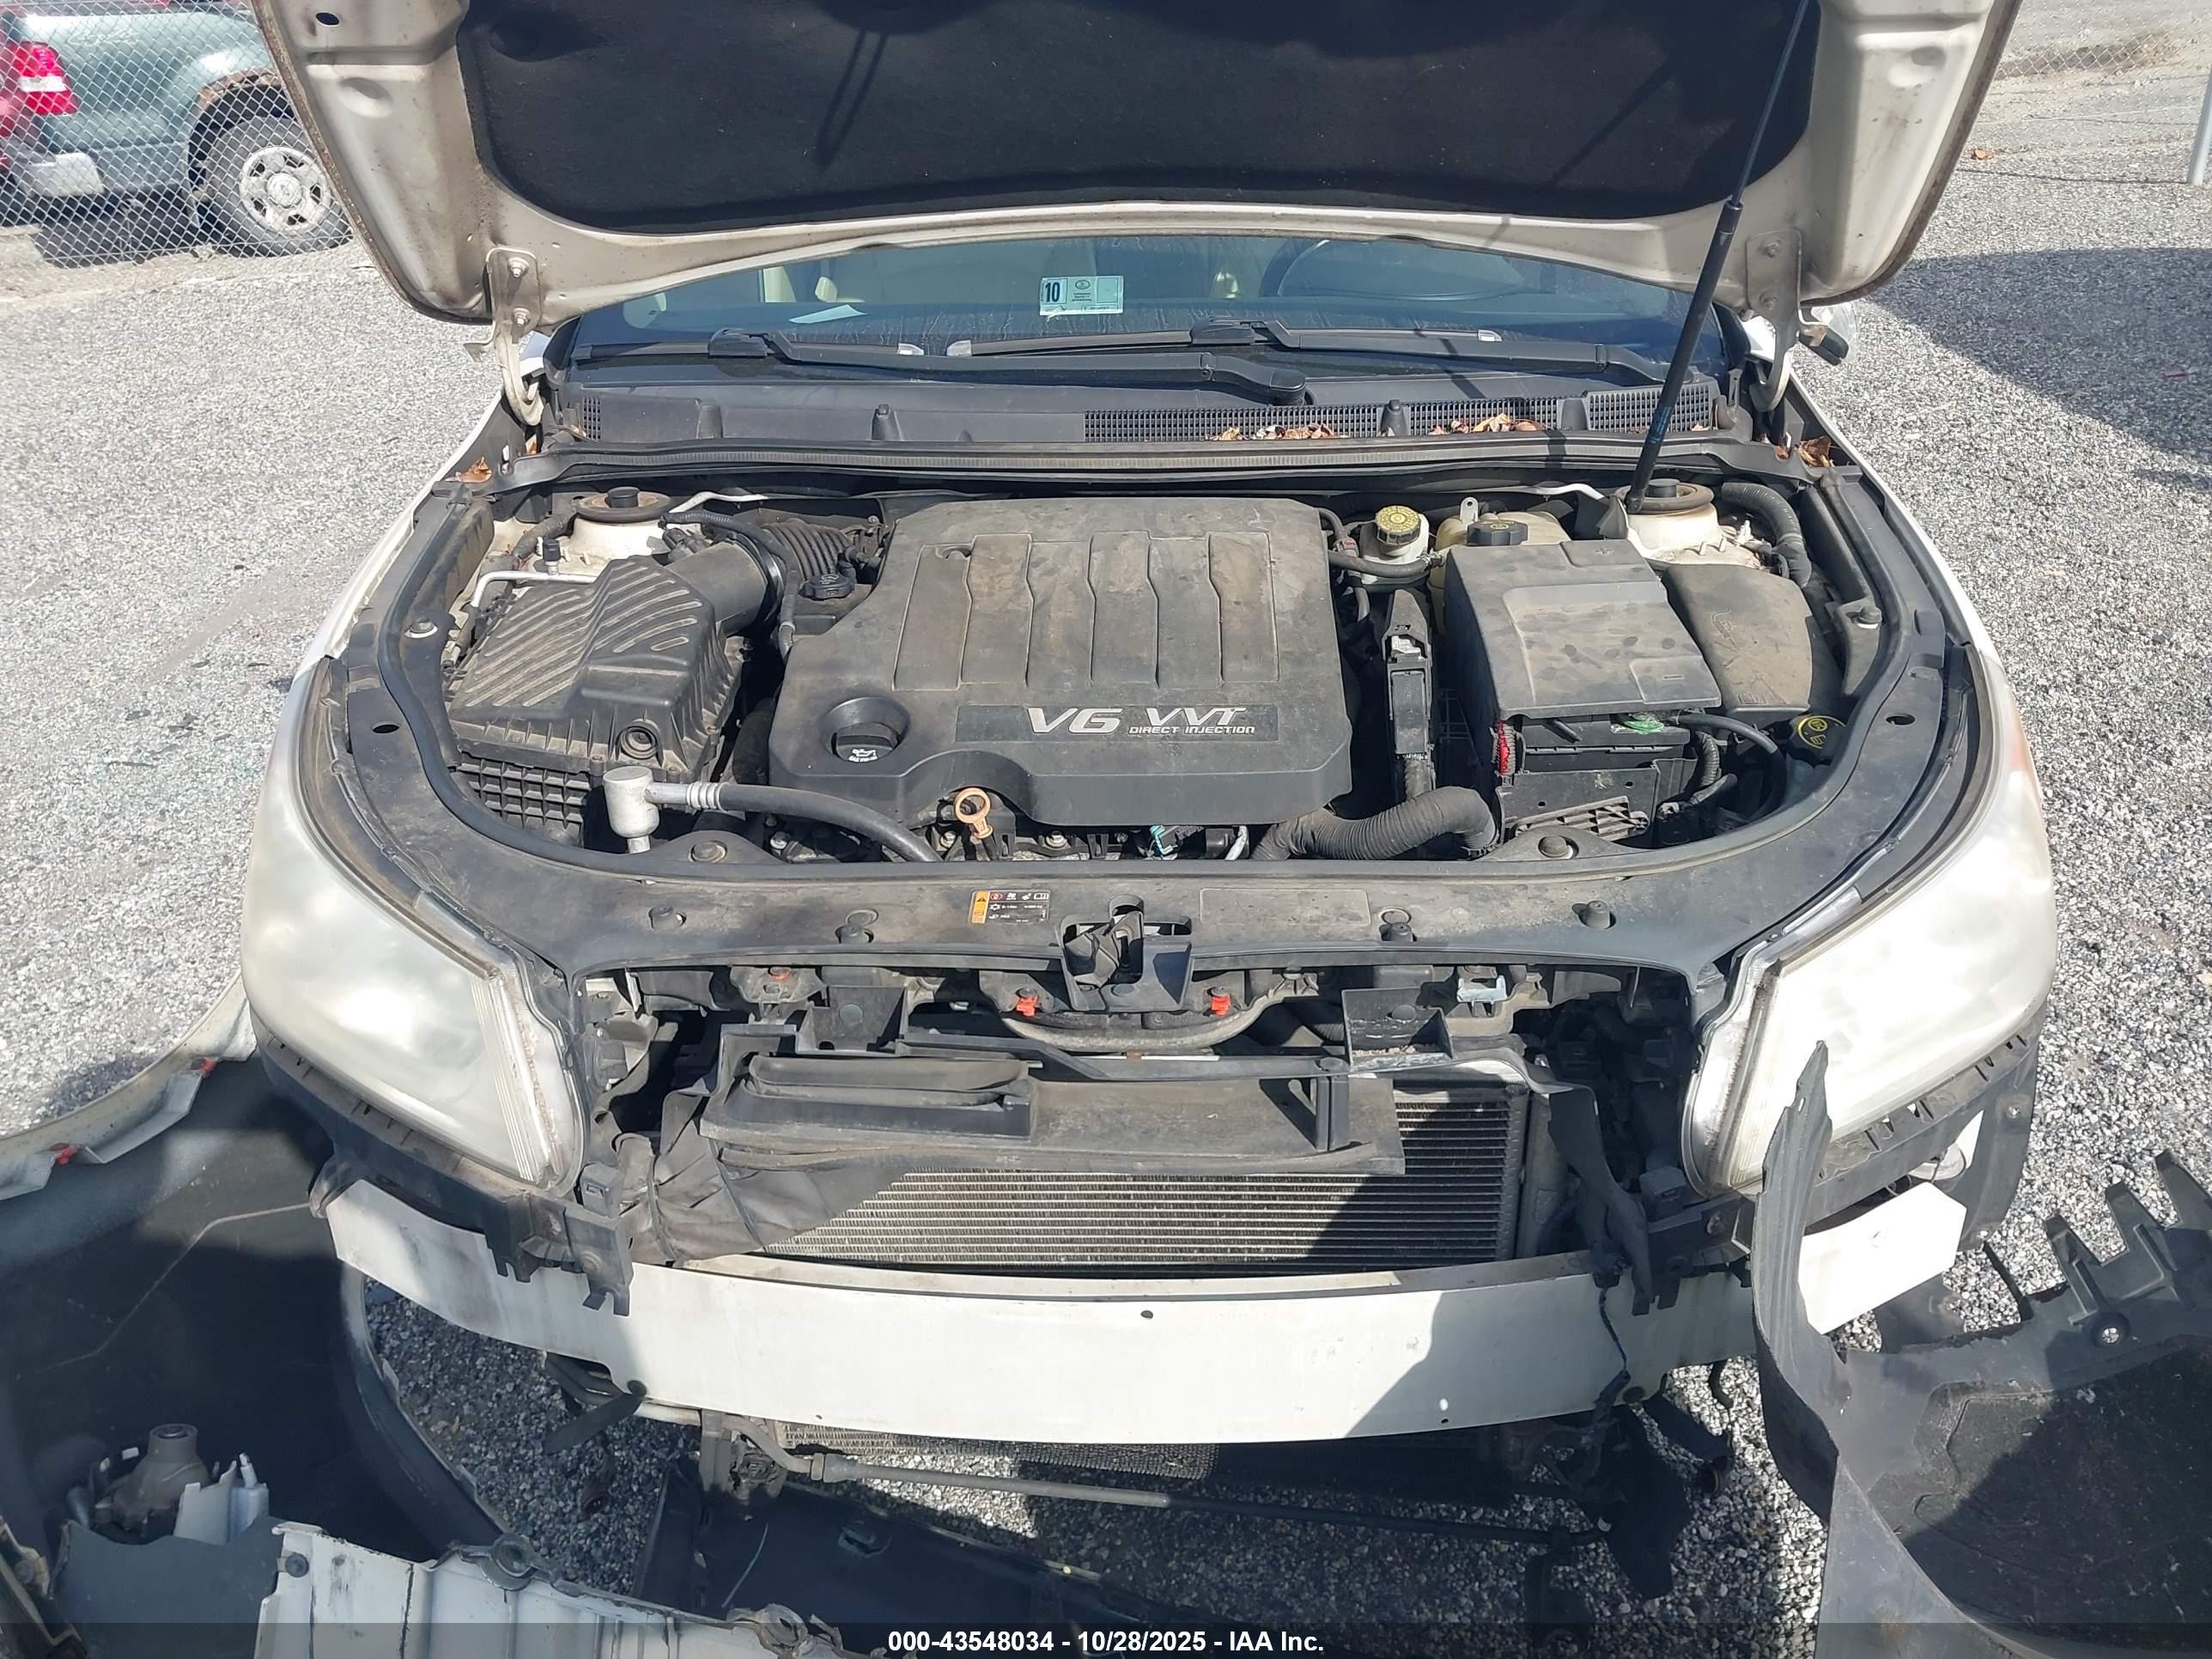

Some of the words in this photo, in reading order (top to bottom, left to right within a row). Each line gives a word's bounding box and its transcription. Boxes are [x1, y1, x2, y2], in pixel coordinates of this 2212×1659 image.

[1045, 282, 1060, 302] 10
[1028, 708, 1123, 732] V6
[1146, 707, 1247, 726] VVT
